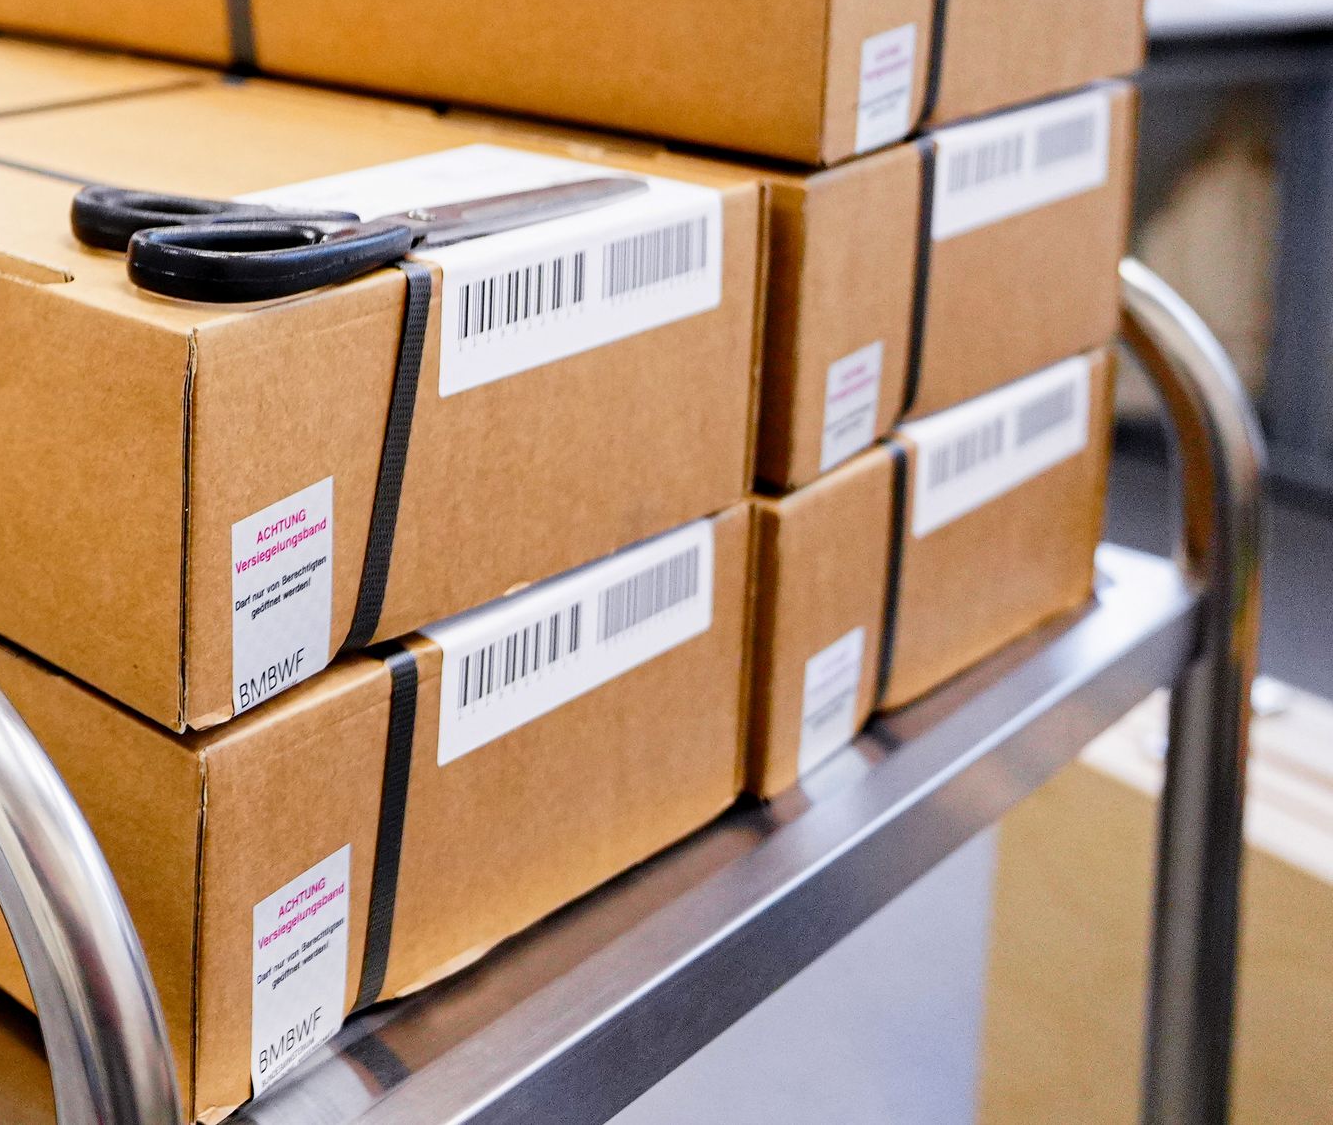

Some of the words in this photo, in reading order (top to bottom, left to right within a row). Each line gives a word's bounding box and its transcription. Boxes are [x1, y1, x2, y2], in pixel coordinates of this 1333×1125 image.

[235, 517, 327, 574] Versiegelungsband
[256, 508, 307, 545] ACHTUNG
[235, 594, 251, 612] Darf
[252, 588, 265, 602] nur
[267, 579, 280, 593] von
[282, 555, 327, 586] Berechtigten
[251, 595, 281, 620] geöffnet
[283, 577, 311, 599] werden!
[239, 647, 305, 709] BMBWF
[258, 882, 345, 950] Versiegelungsband
[278, 877, 326, 918] ACHTUNG
[259, 1006, 322, 1074] BMBWF
